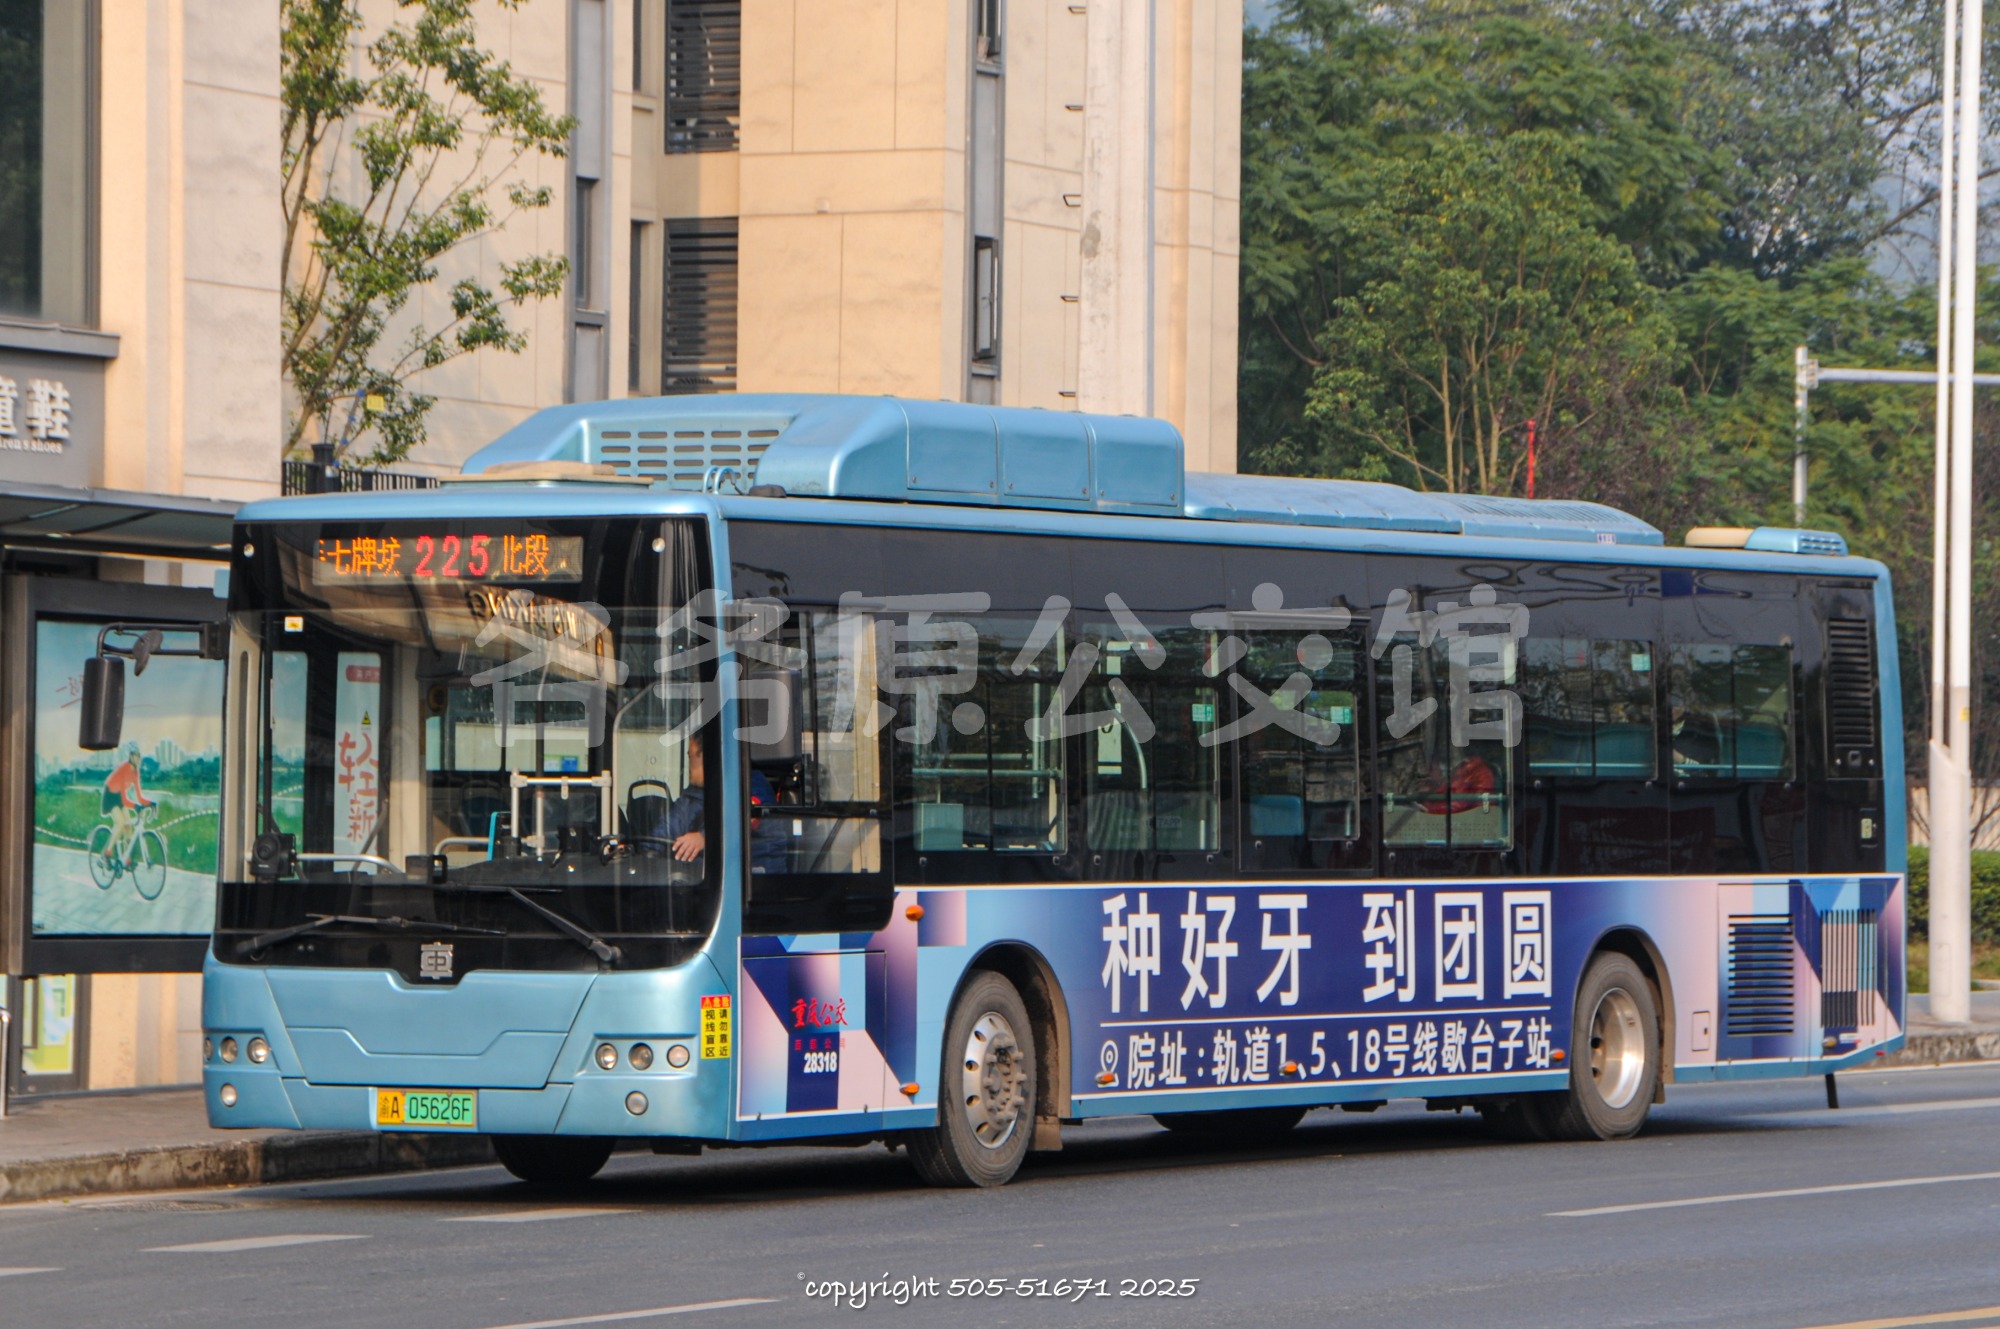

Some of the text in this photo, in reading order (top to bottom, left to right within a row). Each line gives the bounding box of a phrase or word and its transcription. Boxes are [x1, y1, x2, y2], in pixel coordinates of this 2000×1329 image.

[319, 537, 400, 576] 七牌坊
[415, 535, 489, 576] 225
[1101, 889, 1552, 1013] 种好牙 到团圆
[792, 997, 848, 1028] 重庆公交
[803, 1051, 838, 1074] 28318
